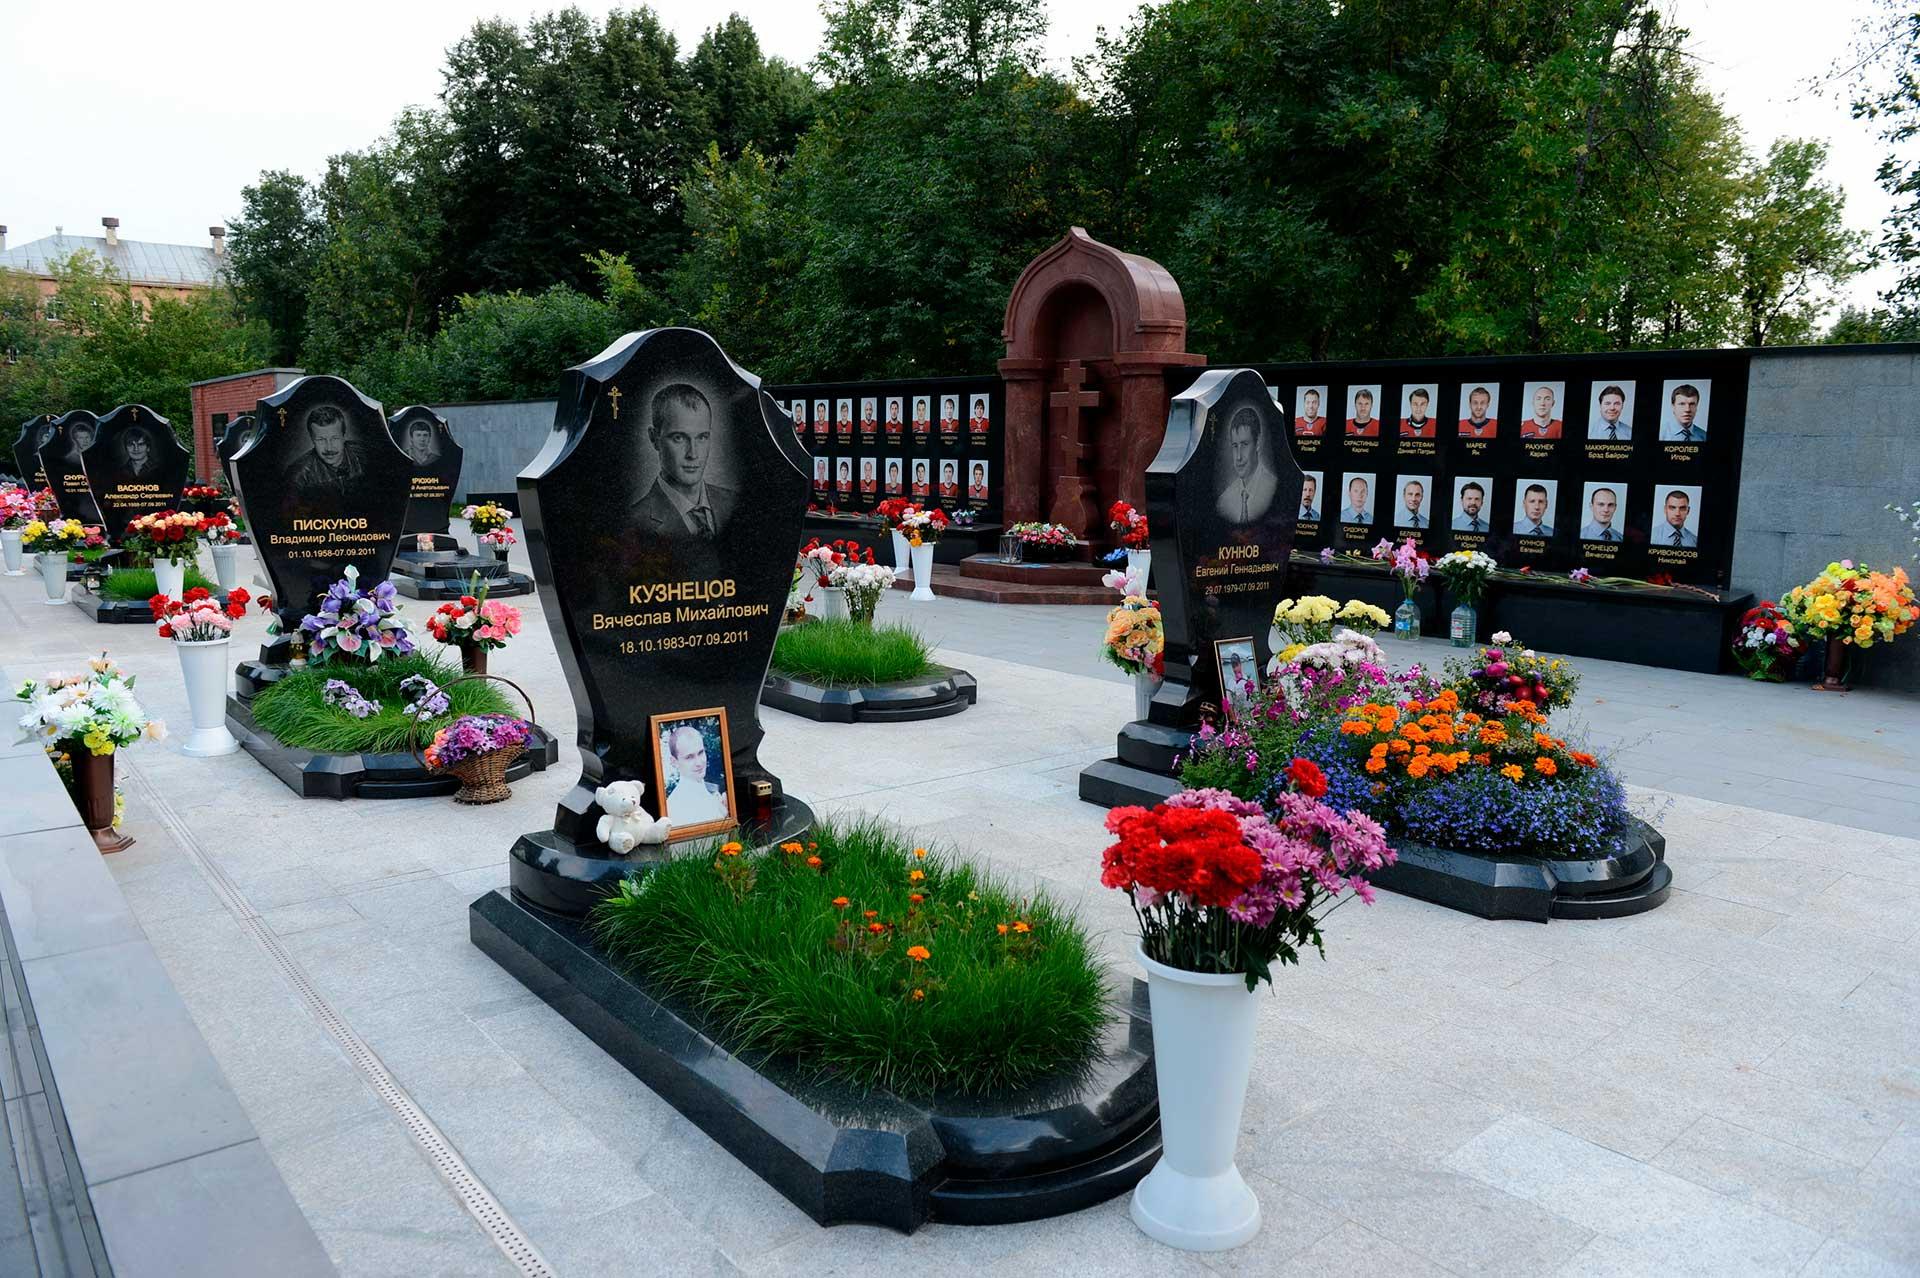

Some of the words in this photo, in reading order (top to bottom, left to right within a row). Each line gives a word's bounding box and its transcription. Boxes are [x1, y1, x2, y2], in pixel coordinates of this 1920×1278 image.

[1525, 443, 1555, 451] РАХУНЕК
[1585, 444, 1634, 452] МАККРИММОН
[1664, 445, 1699, 453] КОРОЛЕВ
[1605, 452, 1630, 460] Байрон
[117, 484, 160, 492] ВАСЮНОВ
[140, 492, 174, 500] Сергеевич
[293, 518, 368, 531] ПИСКУНОВ
[1343, 526, 1369, 534] СИДОРОВ
[270, 534, 326, 545] Владимир
[328, 532, 391, 542] Леонидович
[1454, 534, 1486, 543] БАХВАЛОВ
[1520, 540, 1545, 548] КУННОВ
[1583, 543, 1619, 553] КУЗНЕЦОВ
[288, 547, 376, 559] 01.10.1958-07.09.2011
[1218, 544, 1260, 560] КУННОВ
[1519, 546, 1544, 554] Евгений
[1648, 548, 1699, 559] КРИВОНОСОВ
[1585, 551, 1616, 560] Вячеслав
[1658, 556, 1687, 565] Николай
[1195, 564, 1229, 578] Евгений
[1230, 562, 1280, 575] Геннадьевич
[629, 579, 737, 604] КУЗНЕЦОВ
[1204, 581, 1270, 595] 29.07.1979-07.09.2011
[592, 611, 672, 631] Вячеслав
[676, 603, 770, 623] Михайлович
[619, 629, 749, 655] 18.10.1983-07.09.2011
